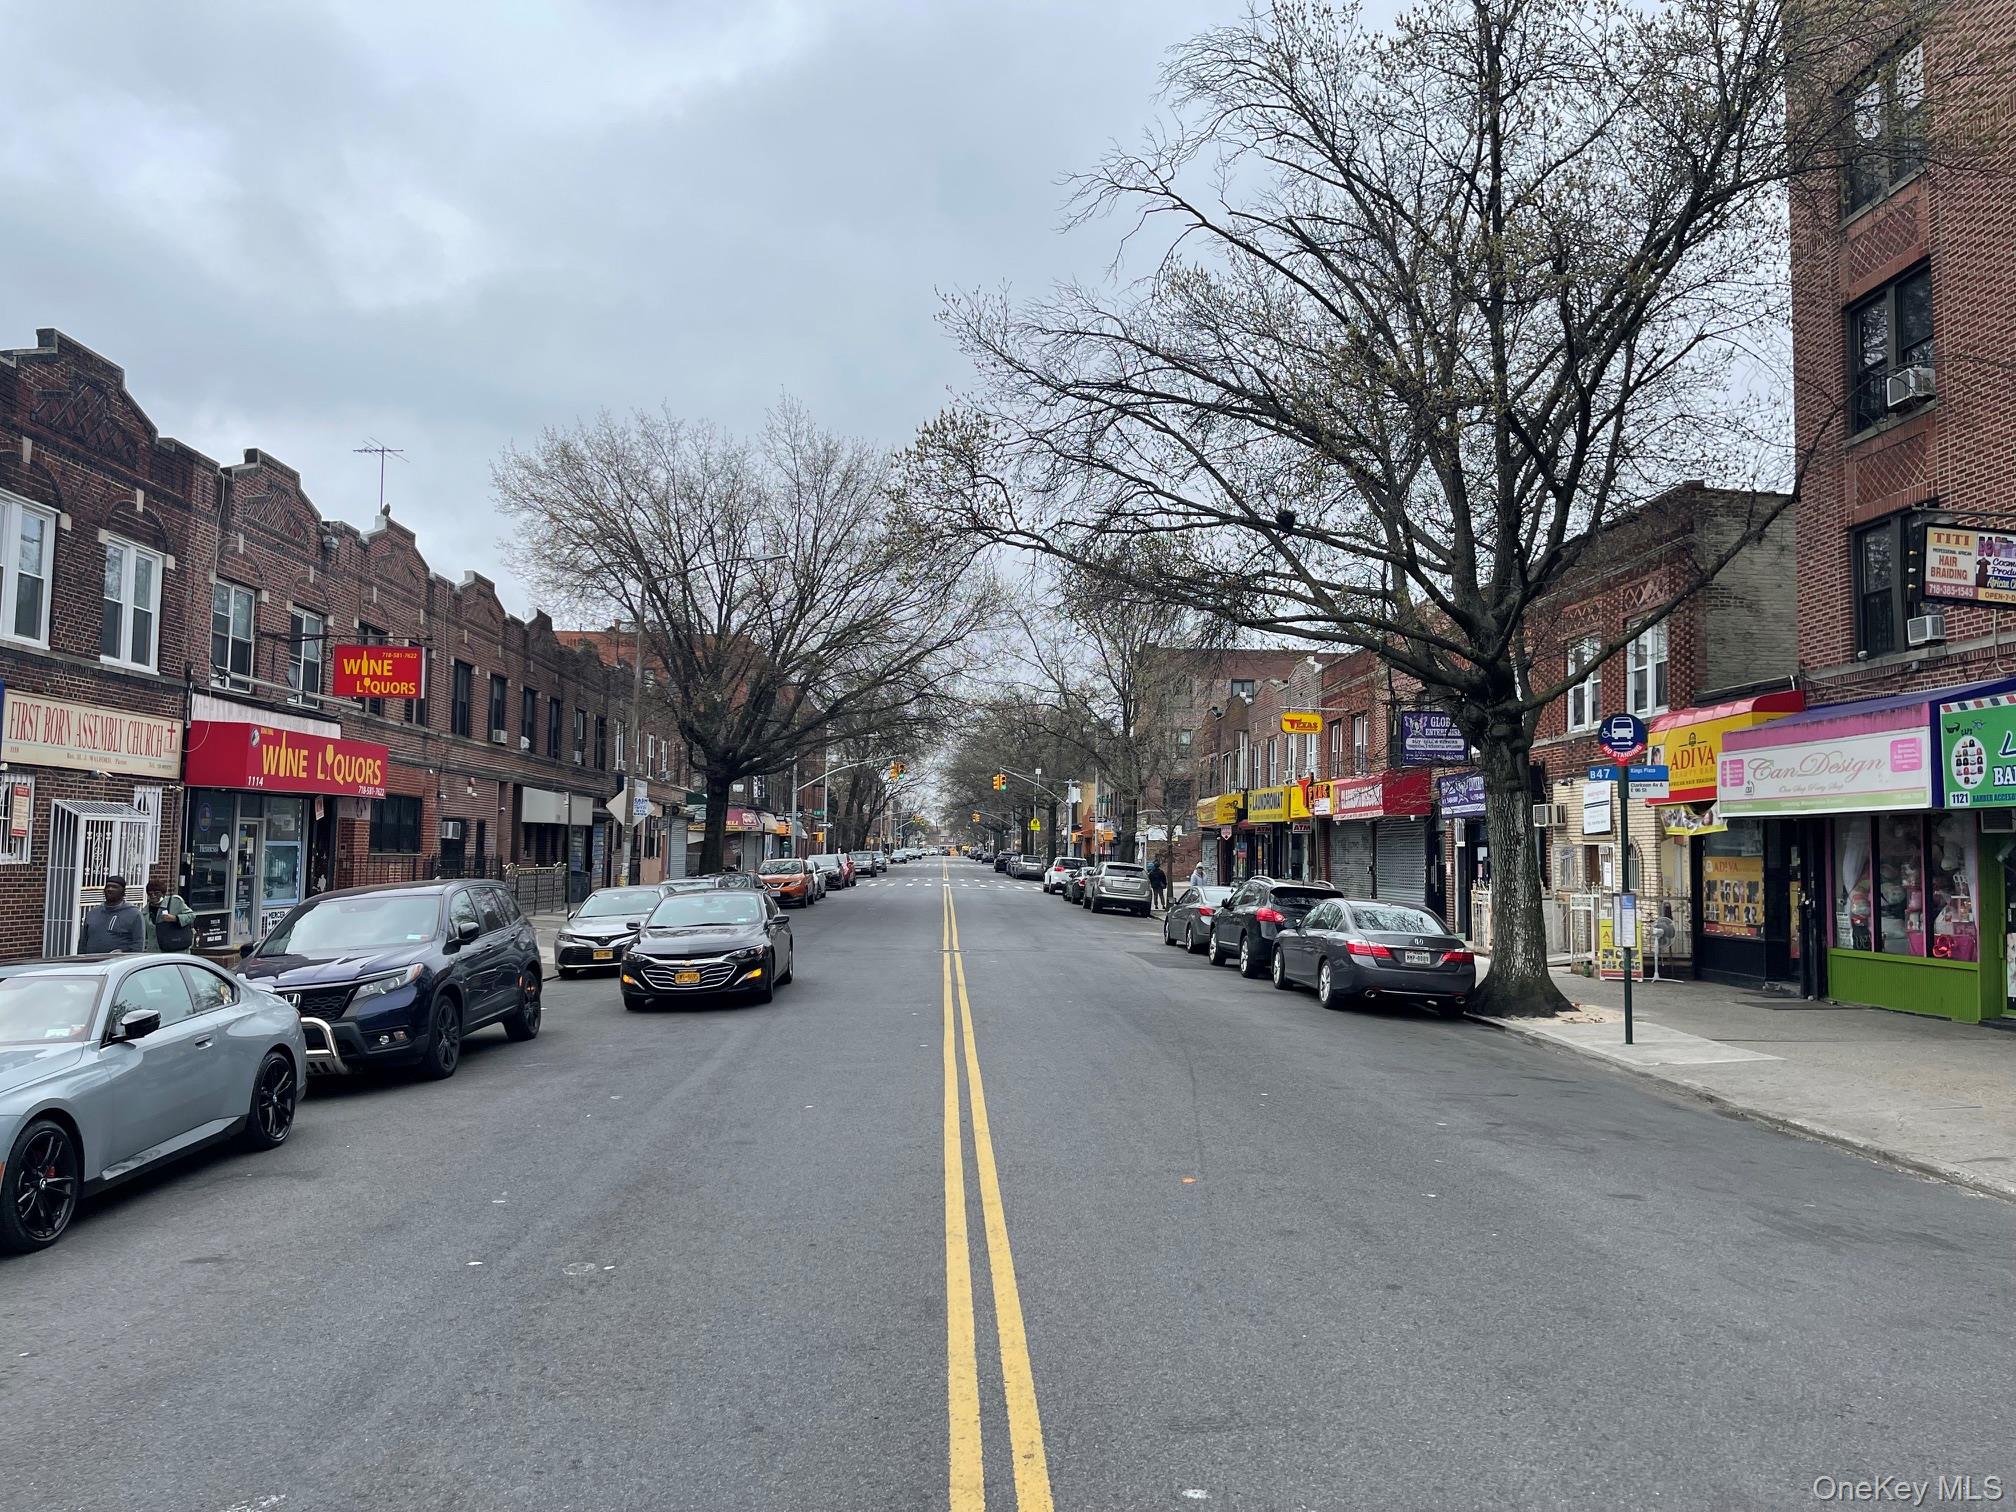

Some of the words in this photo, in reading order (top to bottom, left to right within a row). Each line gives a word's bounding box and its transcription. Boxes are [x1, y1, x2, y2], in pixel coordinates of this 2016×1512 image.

[1934, 532, 1970, 546] TITI
[1938, 554, 1958, 567] HAIR
[1930, 566, 1968, 581] BRAIDING
[356, 677, 416, 695] LIQUORS
[9, 701, 41, 742] FIRST
[43, 707, 73, 746] BORN
[75, 711, 125, 753] ASSEMBLY
[127, 720, 164, 758] CHURCH
[1603, 744, 1612, 755] NO
[1612, 744, 1643, 759] STANDING
[1670, 745, 1716, 771] ADIVA
[317, 744, 382, 785] LIQUORS
[1590, 768, 1610, 779] B47
[1993, 766, 2016, 786] BA
[247, 775, 264, 787] 1114
[1951, 793, 1968, 804] 1121
[1294, 824, 1311, 832] ATM
[1713, 860, 1739, 873] ADIVA
